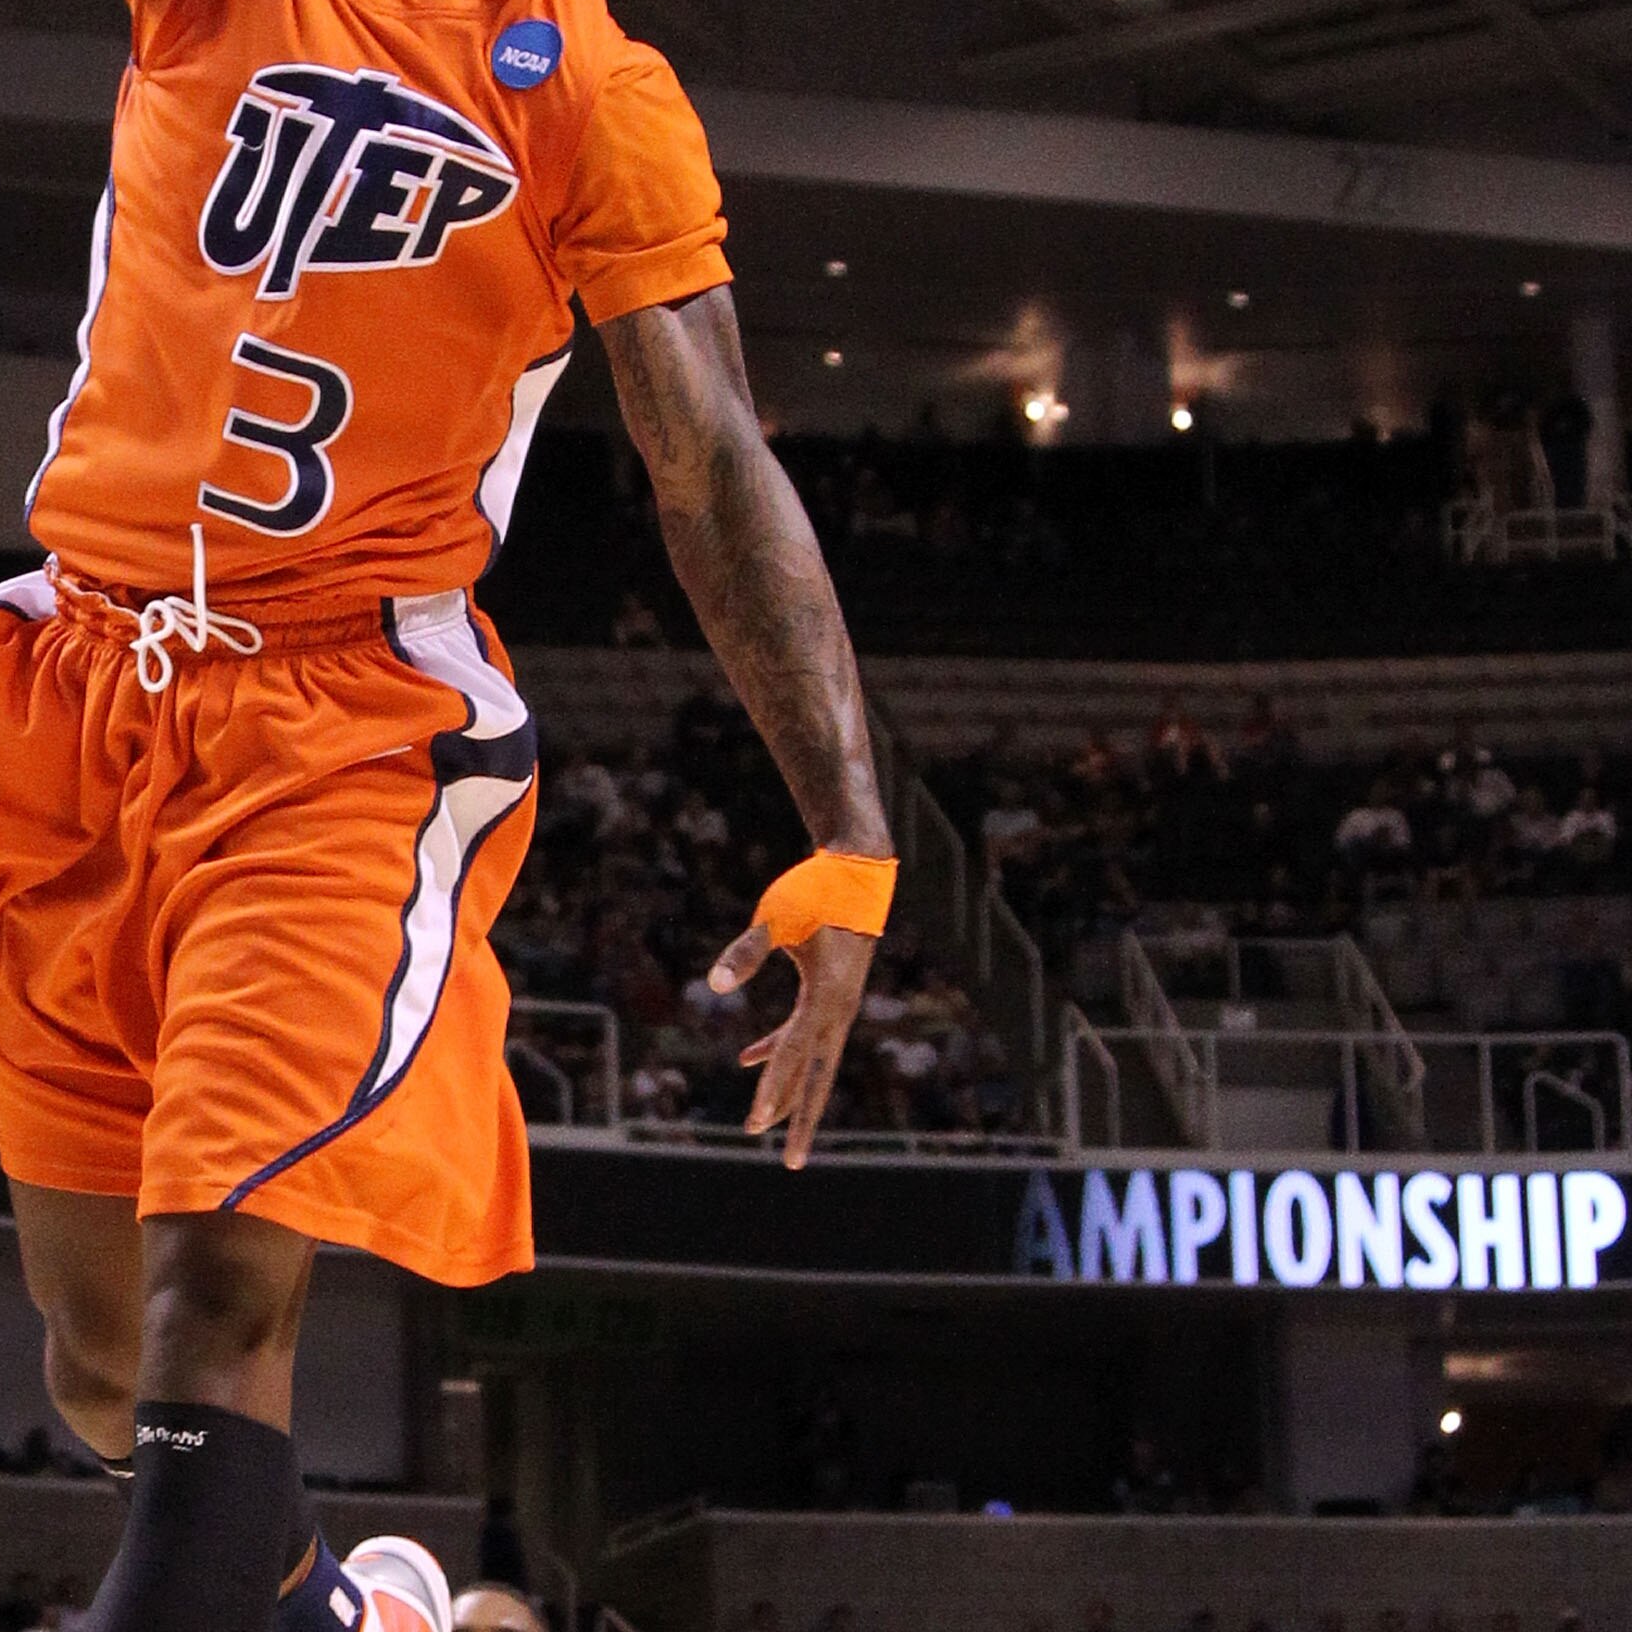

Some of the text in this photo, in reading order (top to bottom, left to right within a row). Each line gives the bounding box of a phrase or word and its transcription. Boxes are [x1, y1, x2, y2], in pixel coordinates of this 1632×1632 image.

[499, 46, 552, 74] NCAA
[199, 63, 519, 301] UTEP
[198, 332, 354, 538] 3
[1014, 1168, 1628, 1289] AMPIONSHIP
